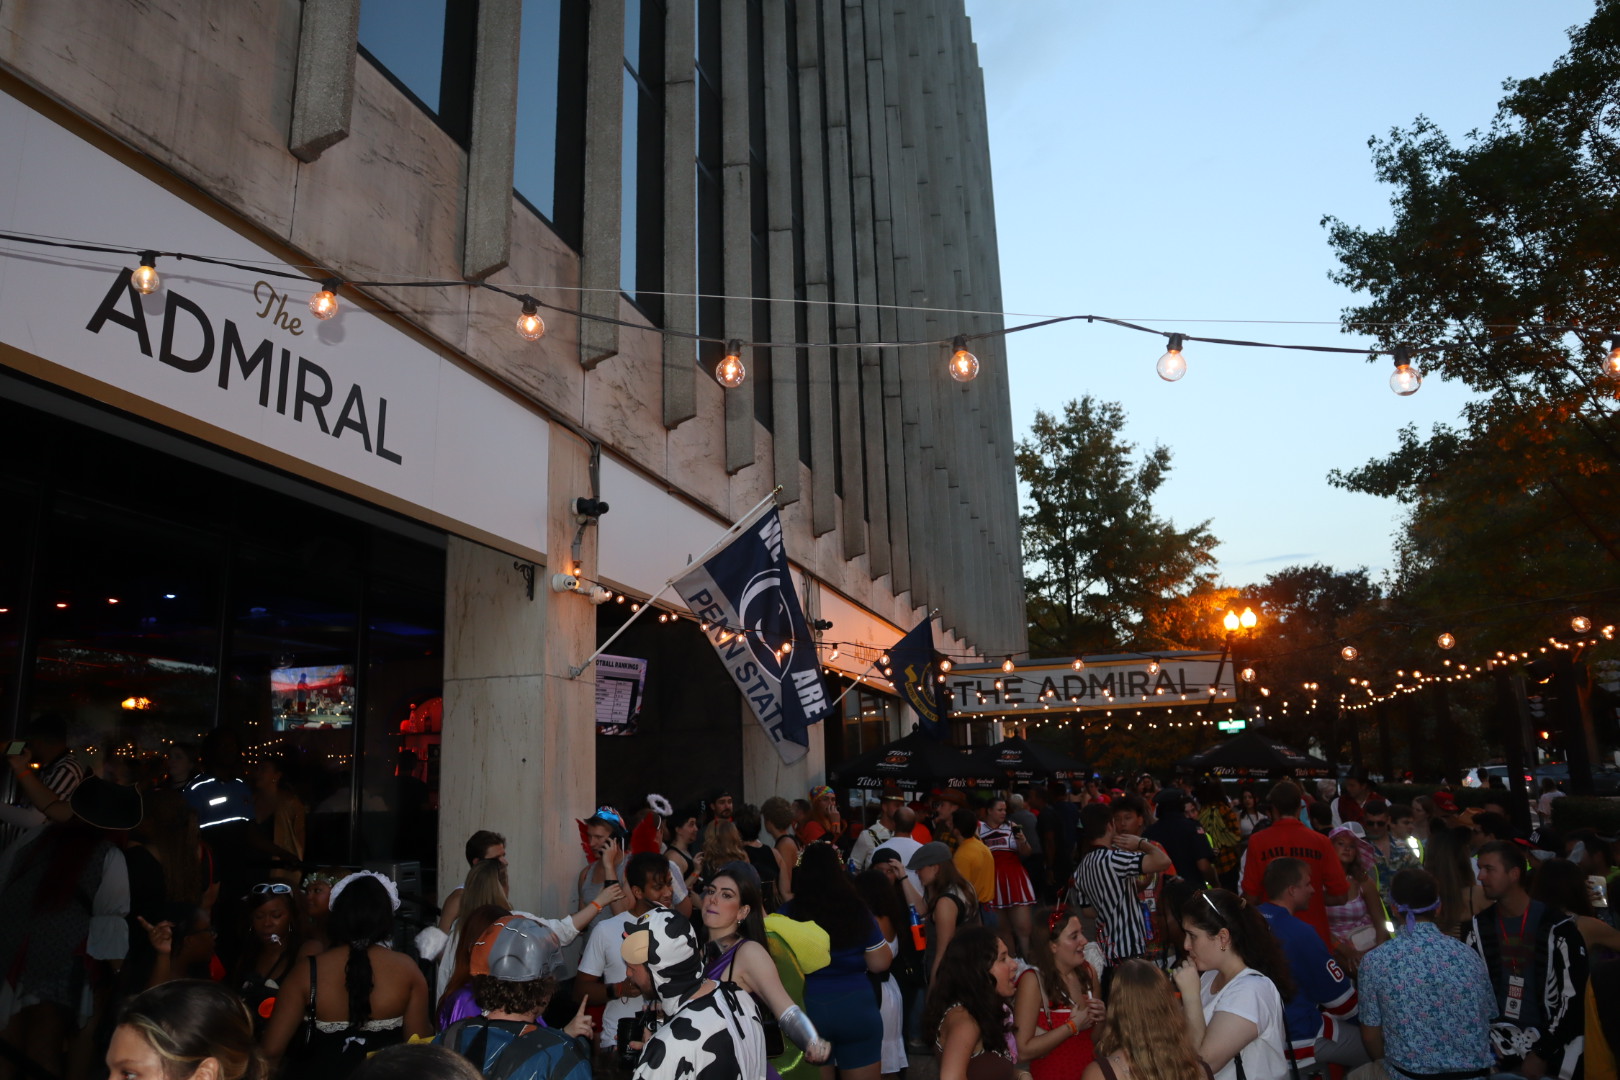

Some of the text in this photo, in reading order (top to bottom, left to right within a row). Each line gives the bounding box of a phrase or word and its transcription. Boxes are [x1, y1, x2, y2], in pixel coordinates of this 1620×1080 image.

[253, 280, 304, 336] The
[85, 266, 402, 466] ADMIRAL
[688, 588, 746, 661] PENN
[791, 668, 828, 719] ARE
[953, 668, 1200, 707] THE ADMIRAL
[856, 776, 883, 787] Tito's
[1261, 847, 1322, 861] JAIL BIRD
[1326, 958, 1344, 983] 6
